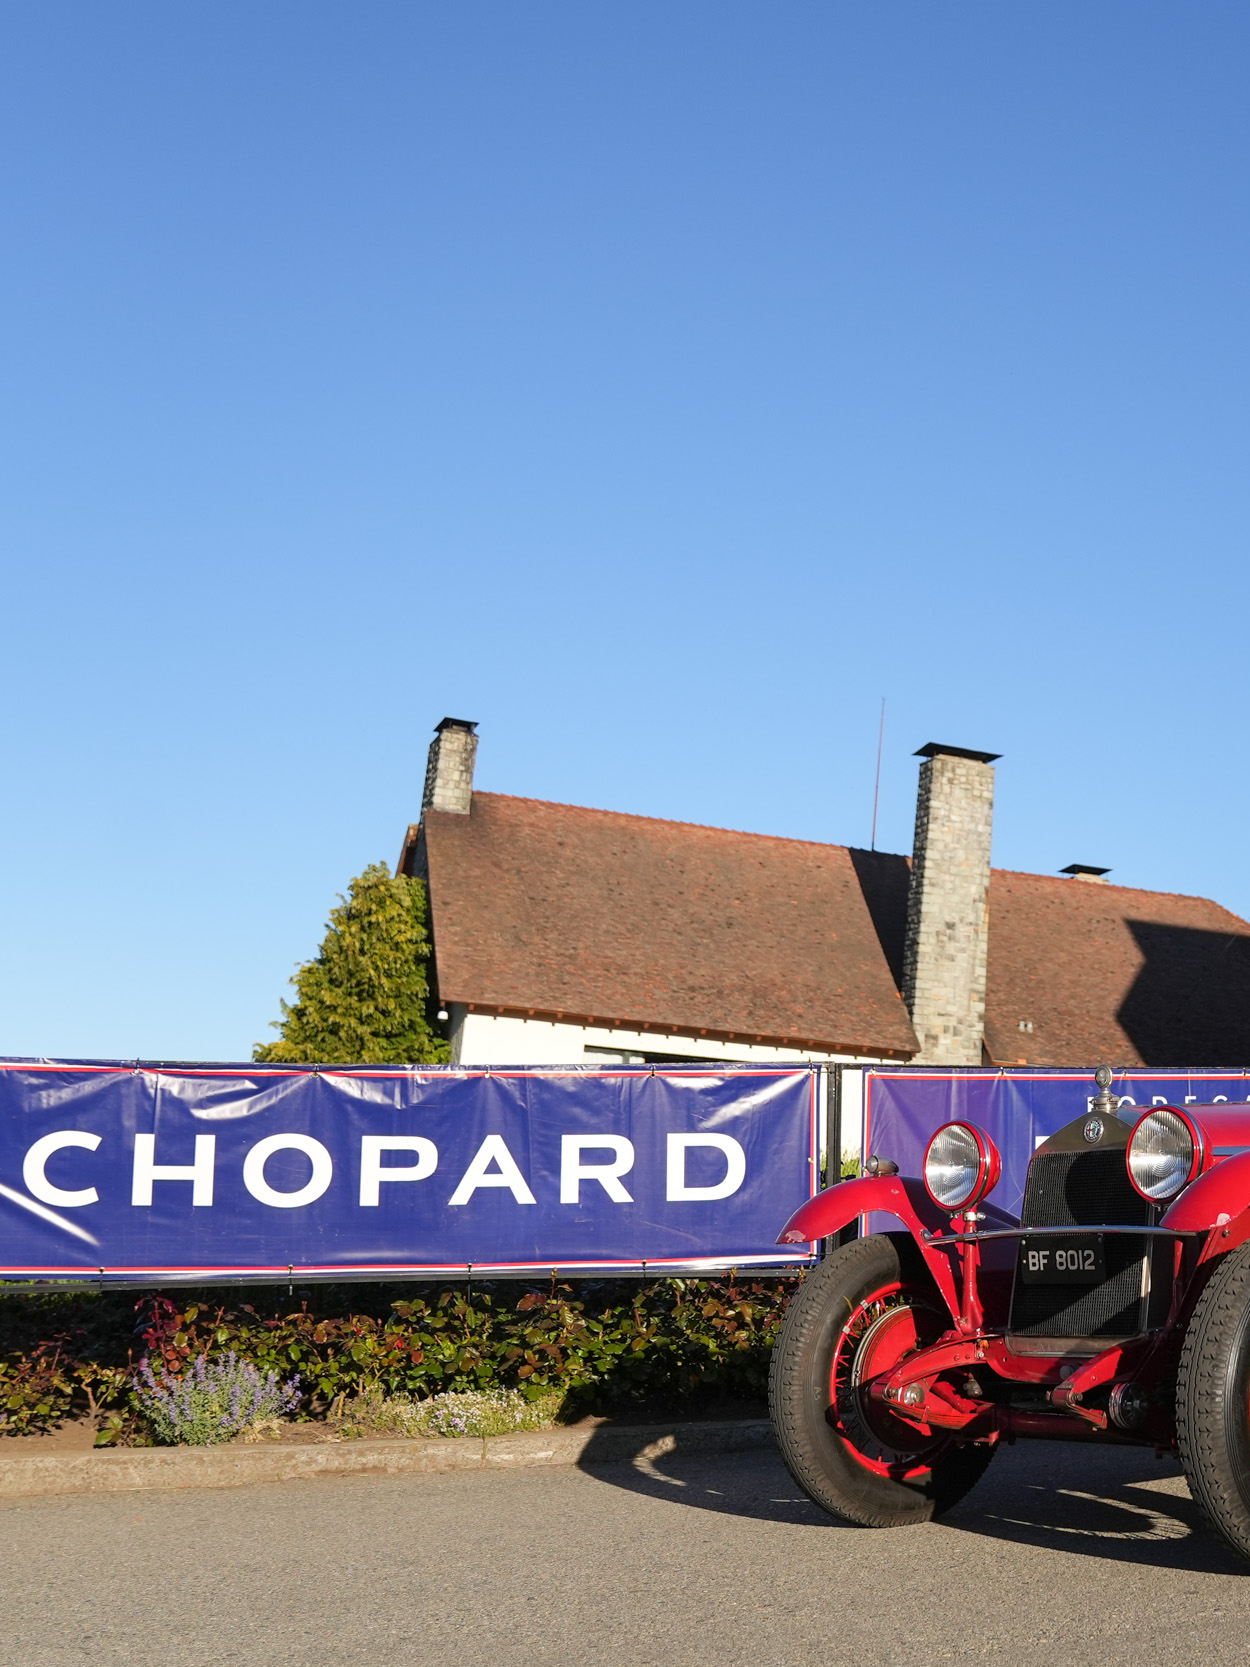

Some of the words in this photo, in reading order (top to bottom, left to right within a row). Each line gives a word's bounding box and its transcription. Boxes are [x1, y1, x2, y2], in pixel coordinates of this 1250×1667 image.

[22, 1130, 748, 1208] CHOPARD
[1027, 1250, 1050, 1272] BF
[1055, 1249, 1097, 1271] 8012
